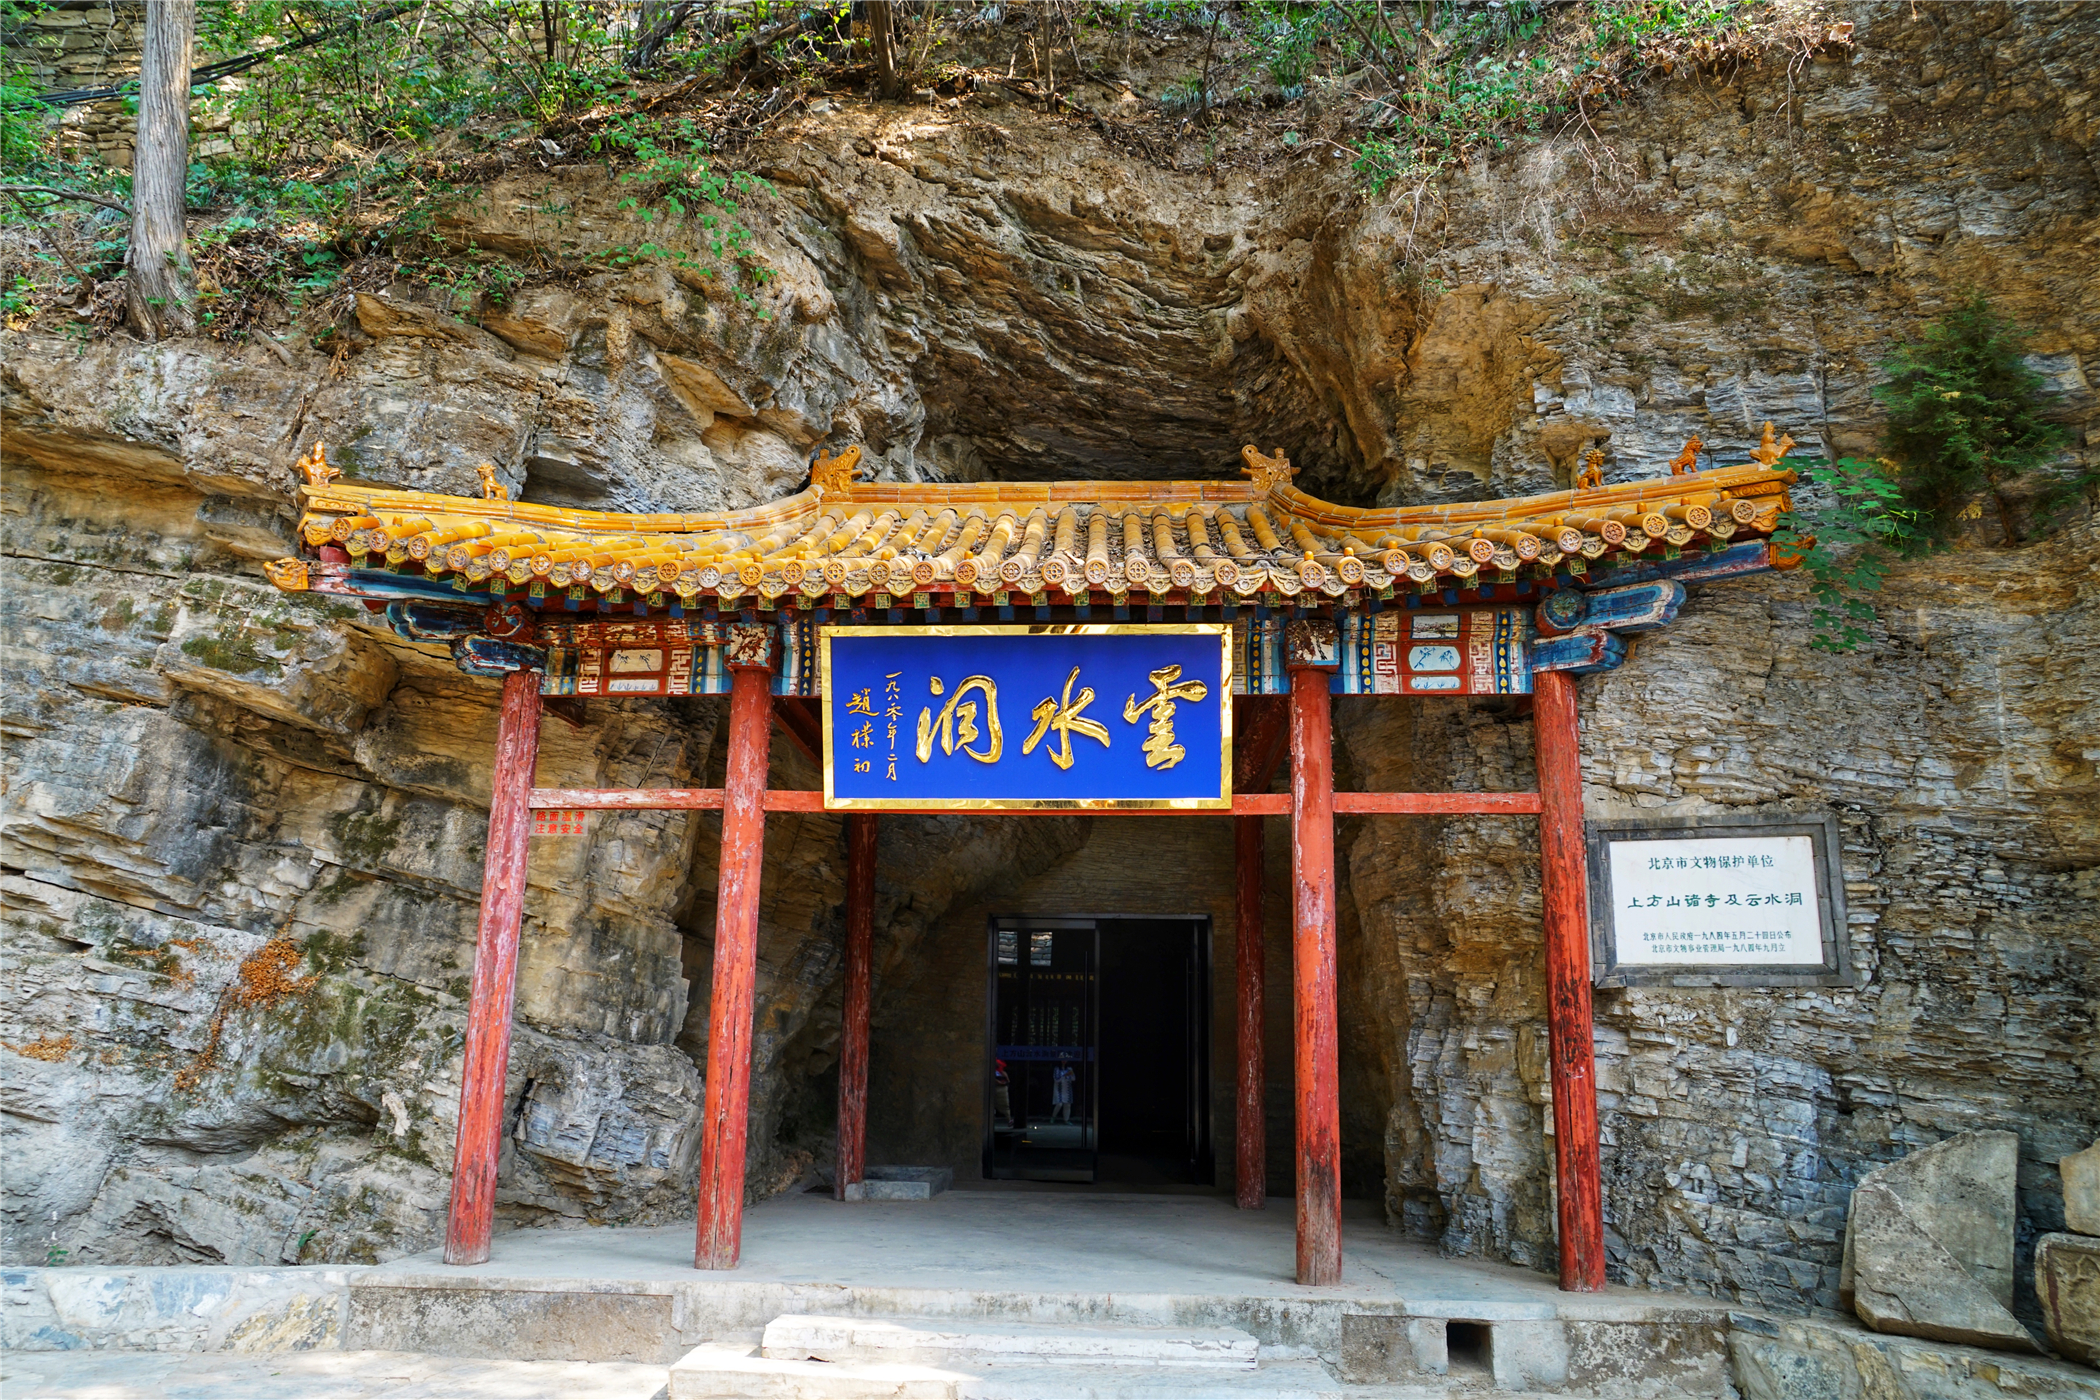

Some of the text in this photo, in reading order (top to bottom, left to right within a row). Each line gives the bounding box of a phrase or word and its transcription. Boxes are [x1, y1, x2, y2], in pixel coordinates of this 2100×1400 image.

[916, 664, 1209, 770] 雲水洞
[534, 823, 583, 834] 注意安全
[1648, 855, 1775, 870] 北京市文物保护单位
[1627, 892, 1803, 908] 上方山诸寺及云水洞
